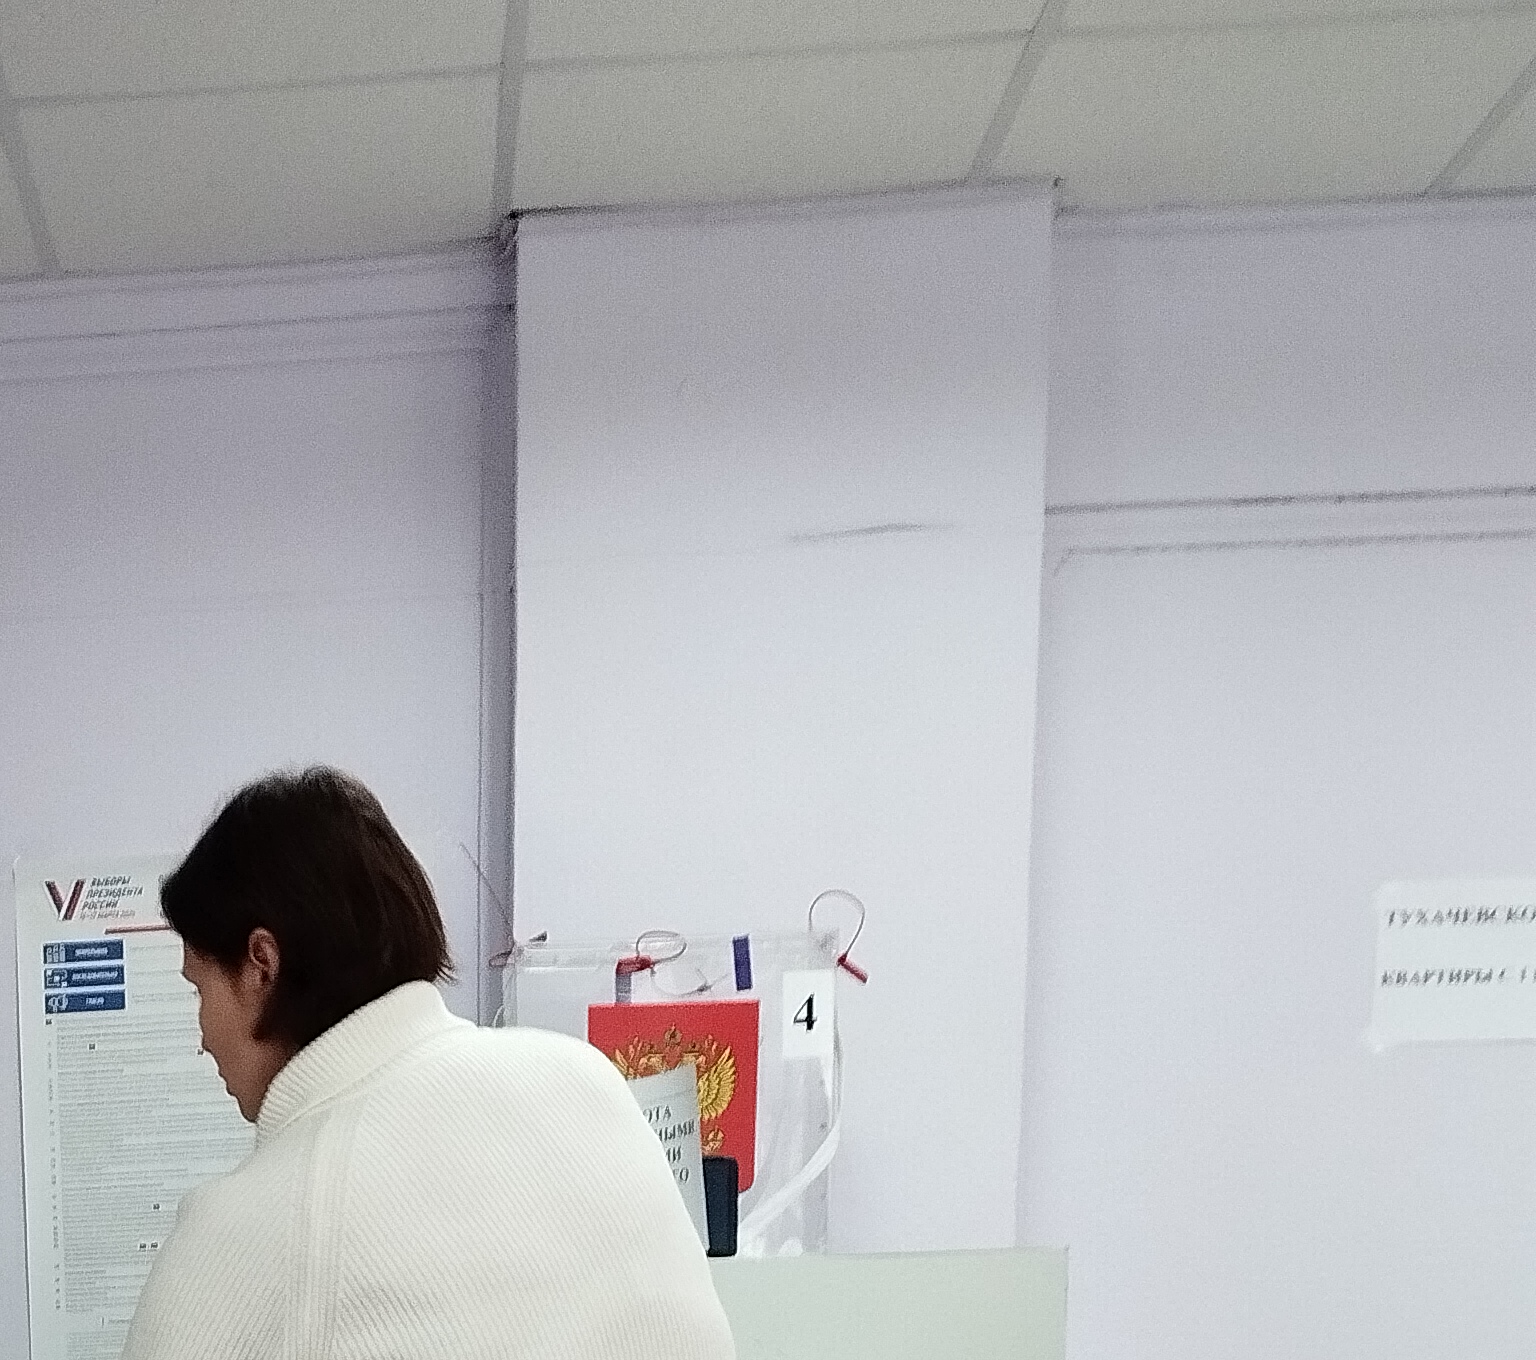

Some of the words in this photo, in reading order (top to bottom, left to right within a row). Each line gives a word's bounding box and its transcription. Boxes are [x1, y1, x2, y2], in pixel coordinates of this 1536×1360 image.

[90, 876, 131, 887] ВЫБОРЫ
[86, 887, 144, 899] ПРЕЗИДЕНТА
[792, 993, 818, 1032] 4
